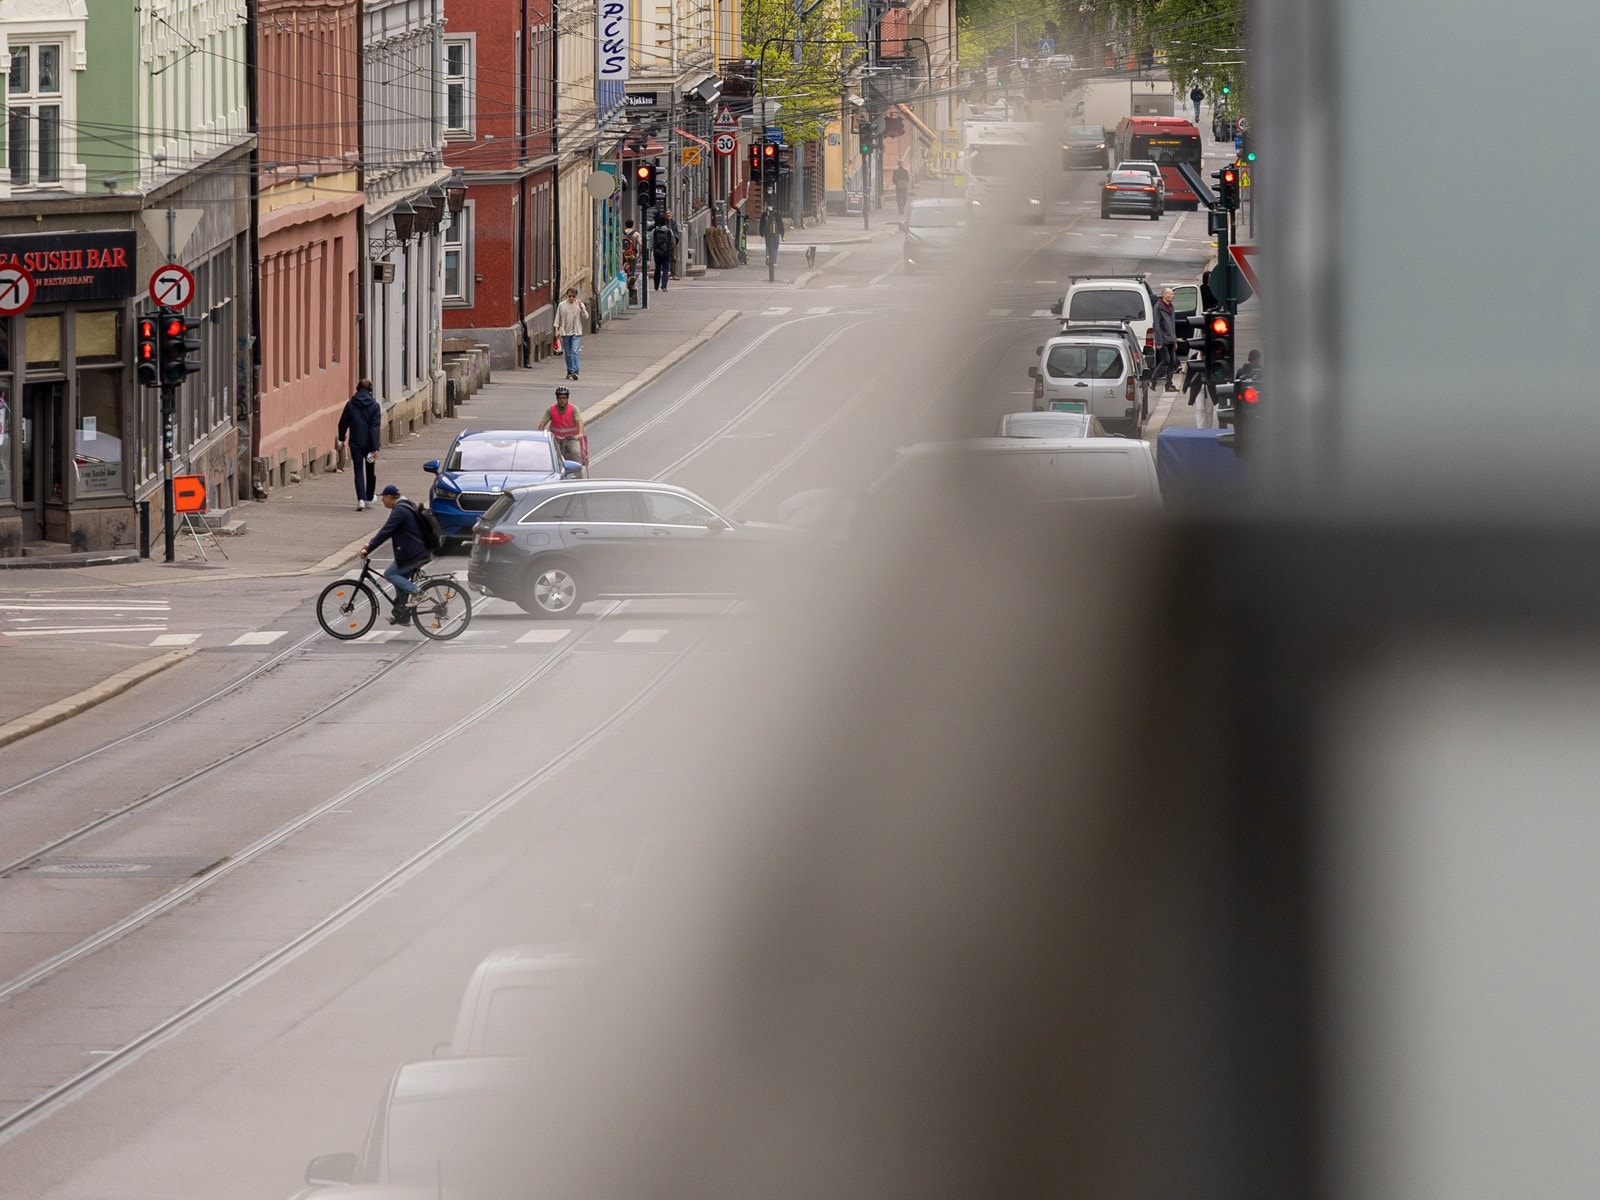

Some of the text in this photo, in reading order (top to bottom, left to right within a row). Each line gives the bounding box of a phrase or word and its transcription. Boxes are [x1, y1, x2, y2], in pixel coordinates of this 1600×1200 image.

[718, 138, 733, 150] 30
[24, 250, 82, 271] SUSHI
[87, 248, 127, 268] BAR
[44, 276, 94, 286] RESTAURANT
